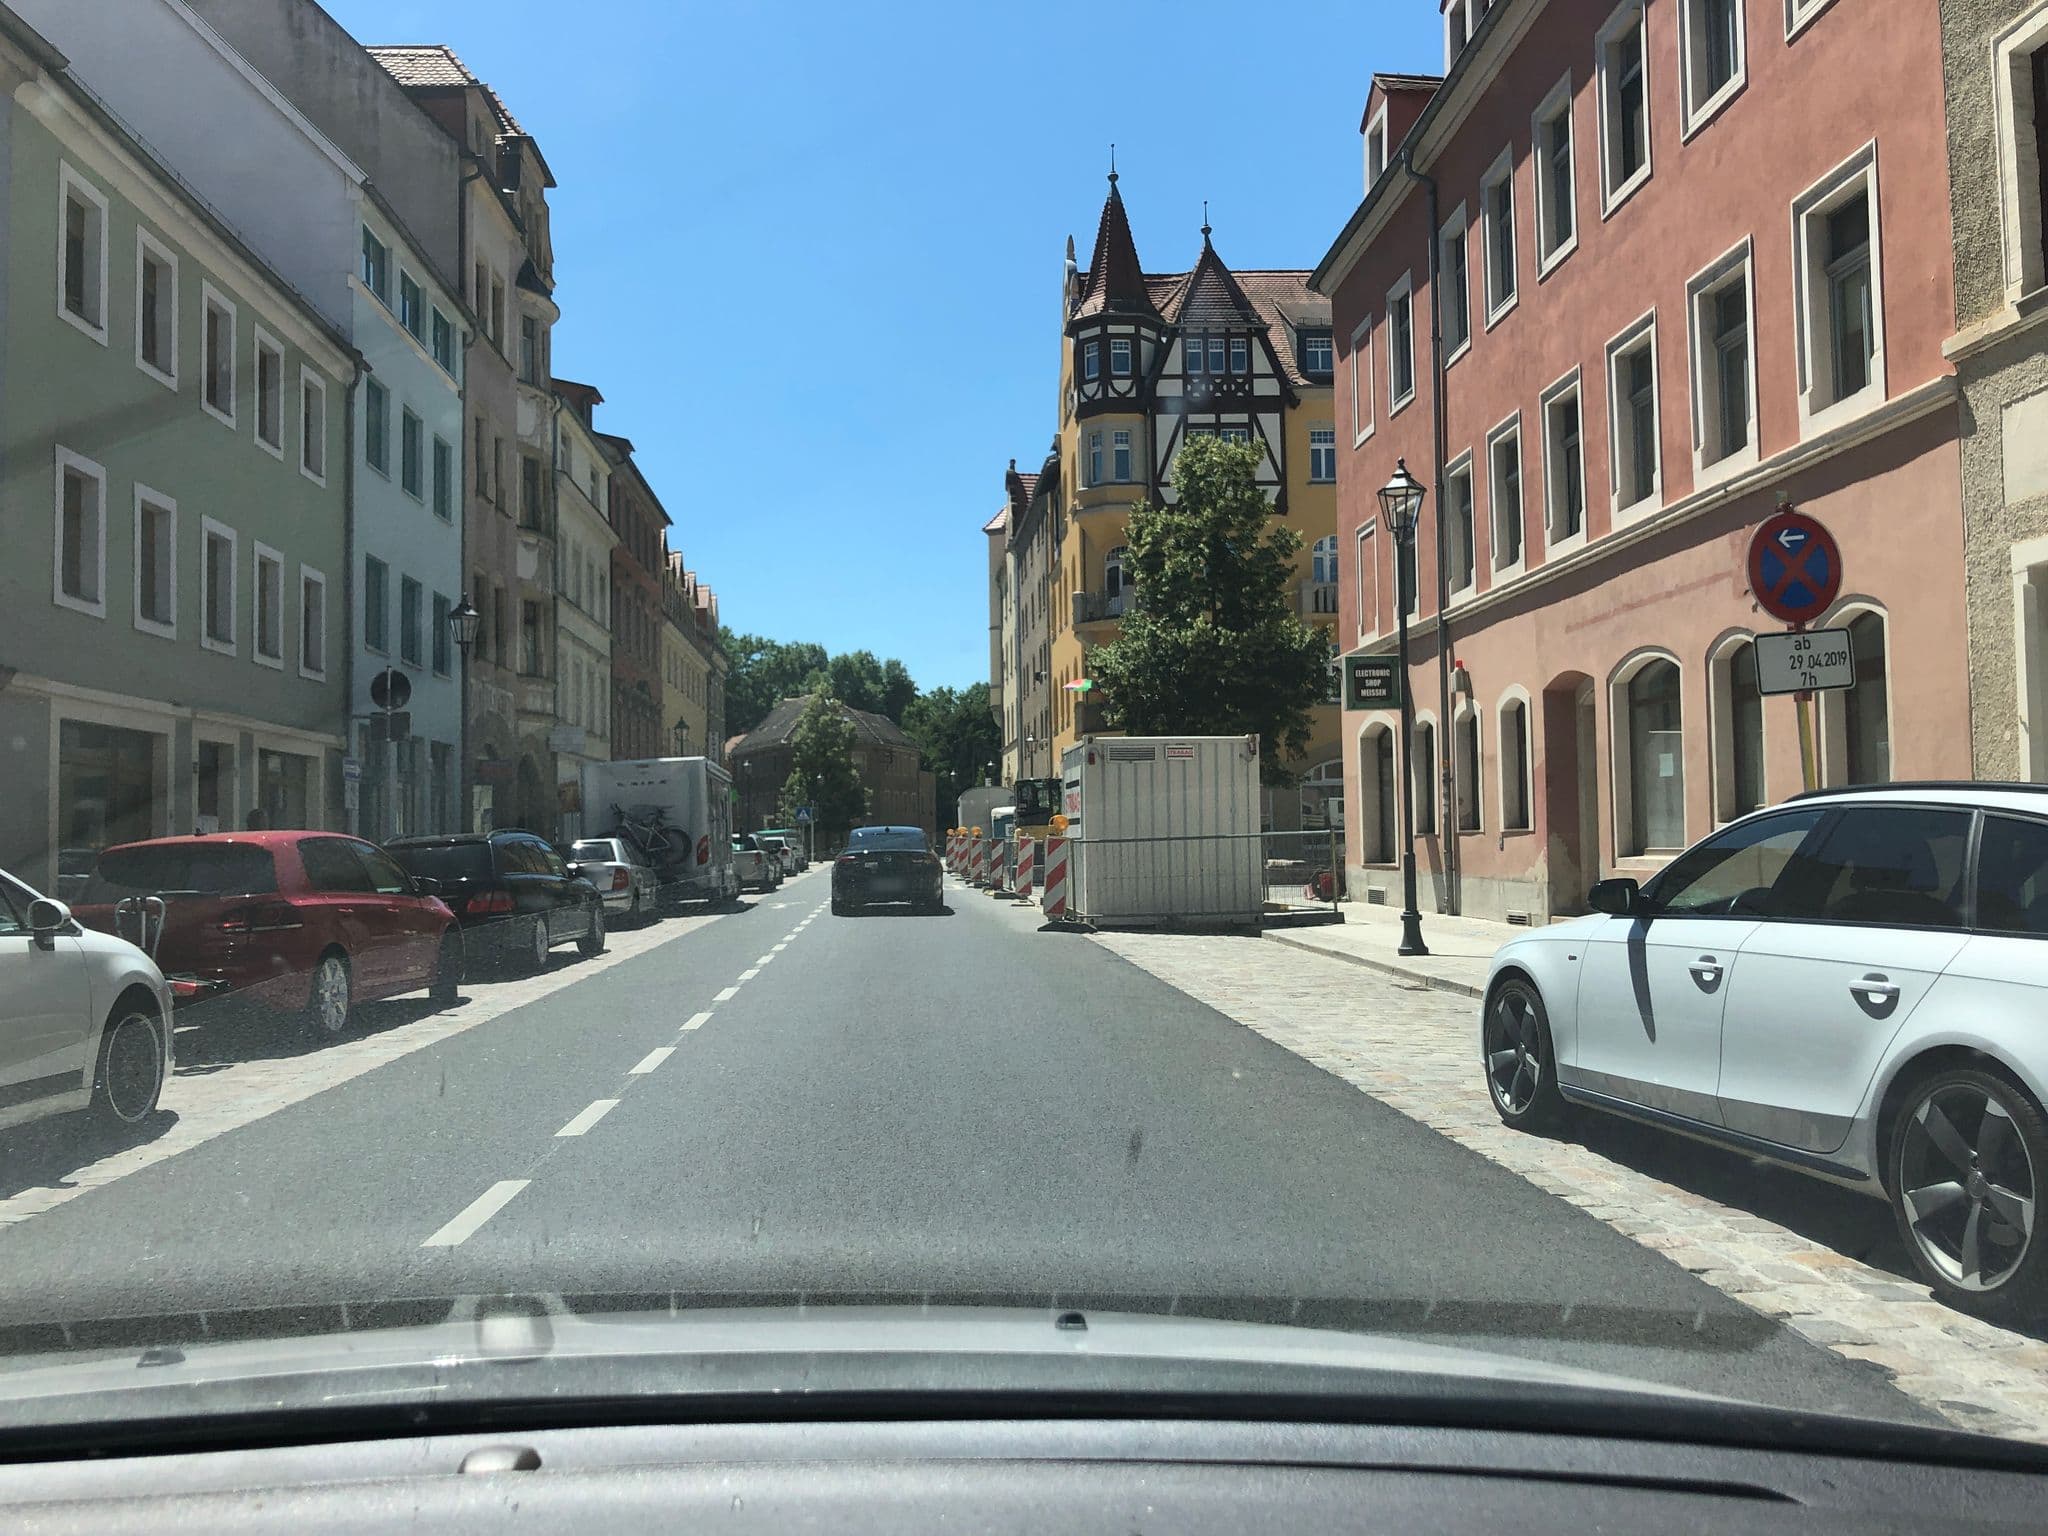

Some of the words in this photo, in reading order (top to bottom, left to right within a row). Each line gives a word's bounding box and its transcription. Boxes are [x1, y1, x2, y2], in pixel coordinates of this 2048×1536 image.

[1794, 636, 1811, 650] ab
[1355, 668, 1390, 678] ELECTRONIC
[1365, 679, 1381, 687] SHOP
[1801, 672, 1817, 686] 7h
[1360, 688, 1386, 697] MEISSEN
